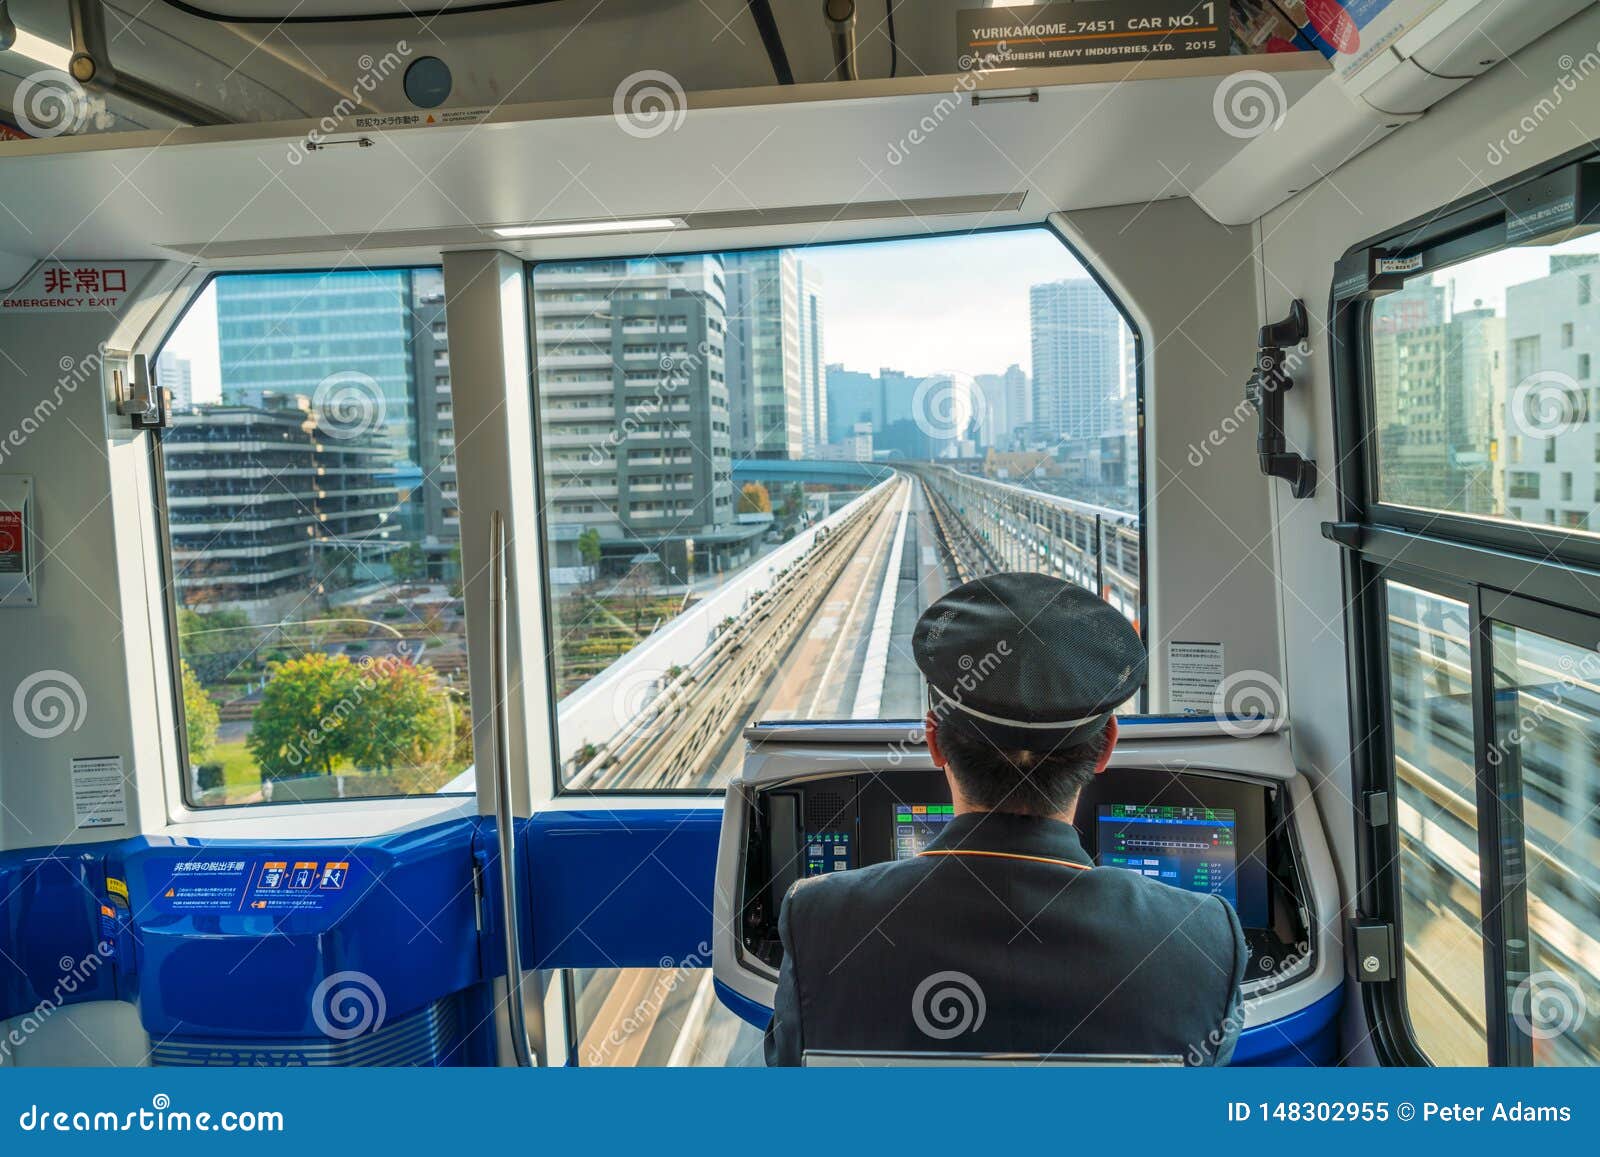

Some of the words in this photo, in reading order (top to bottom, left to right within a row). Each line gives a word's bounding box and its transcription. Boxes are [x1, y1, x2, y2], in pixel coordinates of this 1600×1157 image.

[1127, 17, 1162, 30] CAR
[1168, 15, 1199, 28] NO.
[1202, 1, 1215, 25] 1
[1049, 48, 1083, 58] HEAVY
[1152, 44, 1175, 52] LTD.
[1185, 41, 1216, 50] 2015
[356, 116, 419, 128] 防犯カメラ作動中
[44, 268, 126, 293] 非常口
[3, 298, 85, 308] EMERGENCY
[89, 297, 118, 306] EXIT
[174, 861, 245, 872] 非常時の脱出手順
